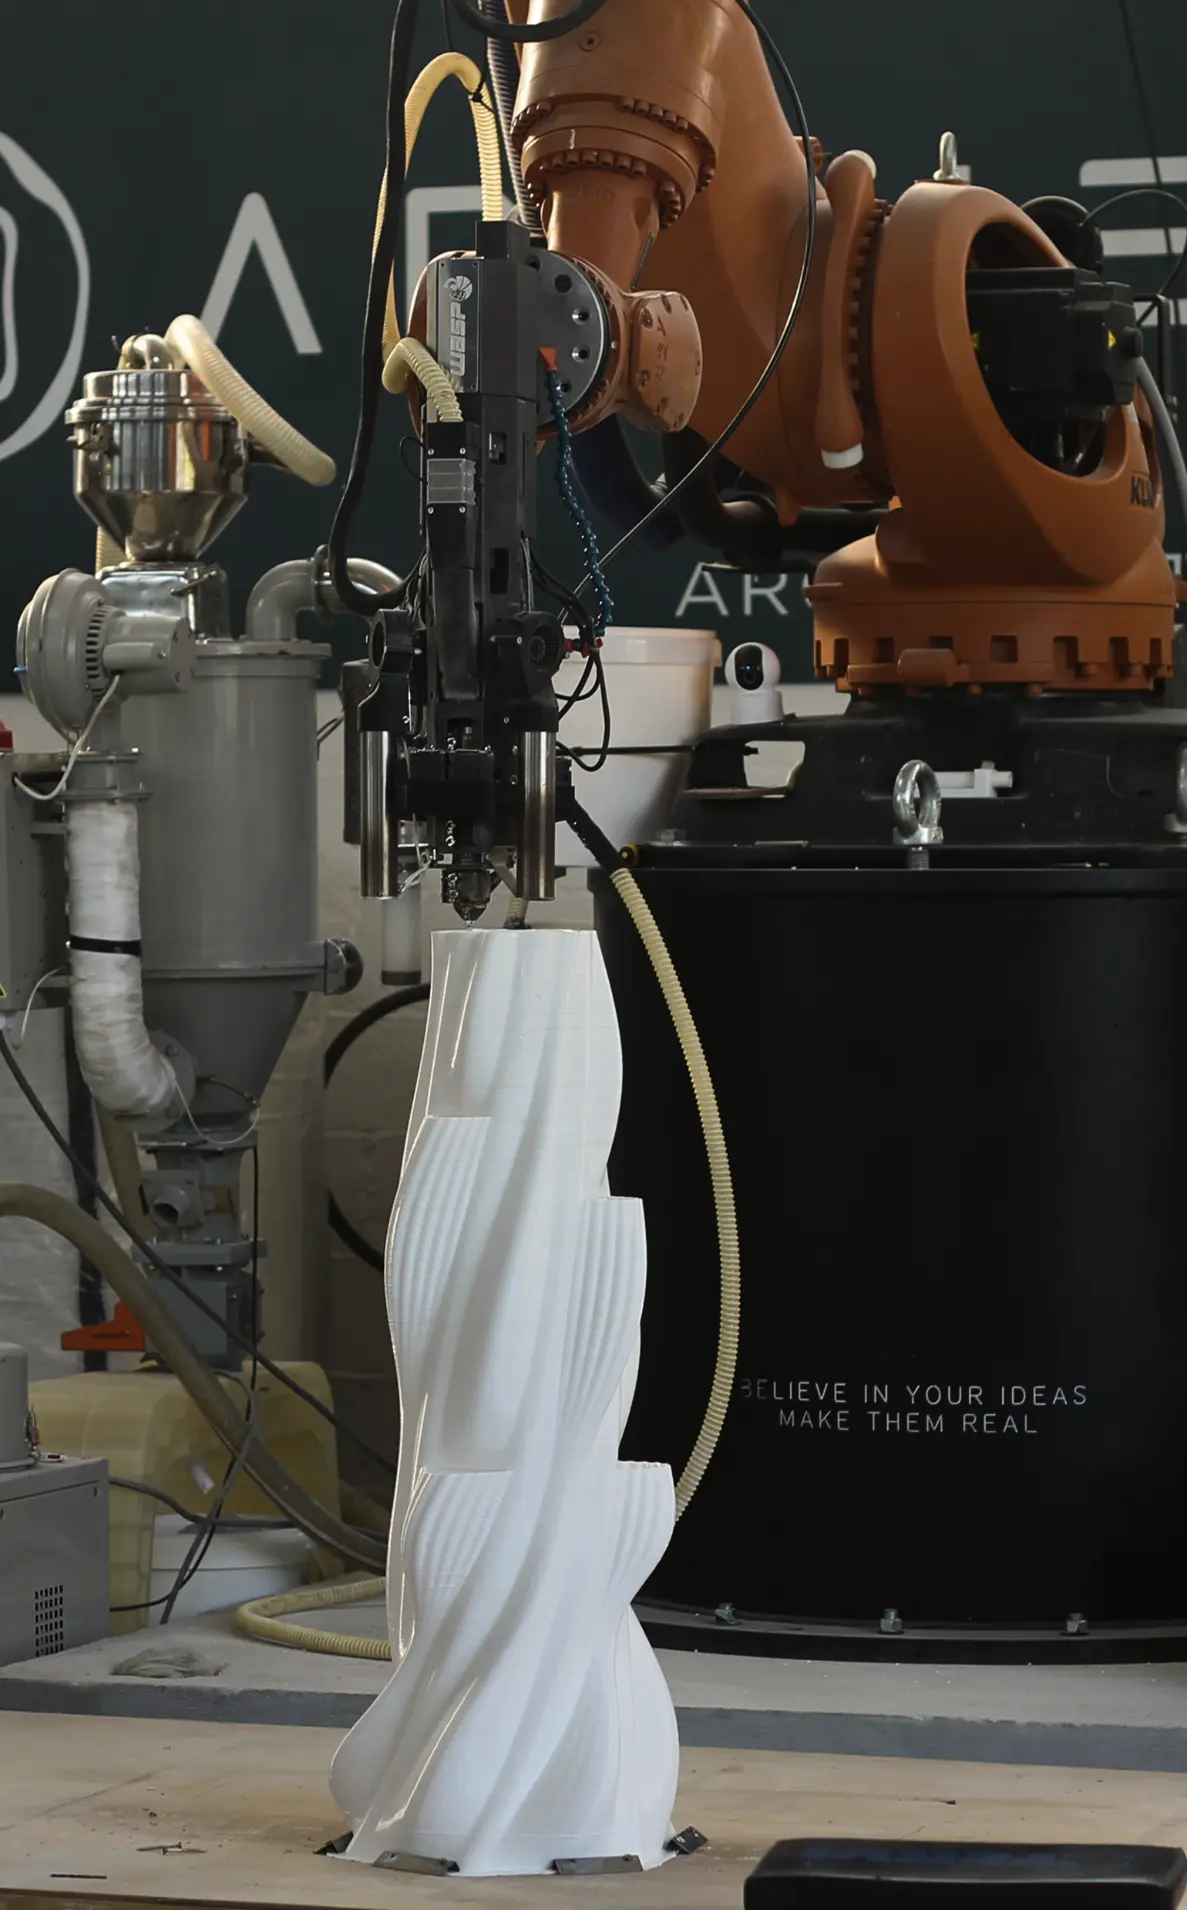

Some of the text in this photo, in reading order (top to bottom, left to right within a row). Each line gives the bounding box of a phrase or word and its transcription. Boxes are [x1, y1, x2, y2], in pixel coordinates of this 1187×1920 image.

[674, 561, 813, 617] AR
[740, 1378, 1088, 1407] BELIEVE IN YOUR IDEAS
[779, 1409, 1038, 1434] MAKE THEM REAL
